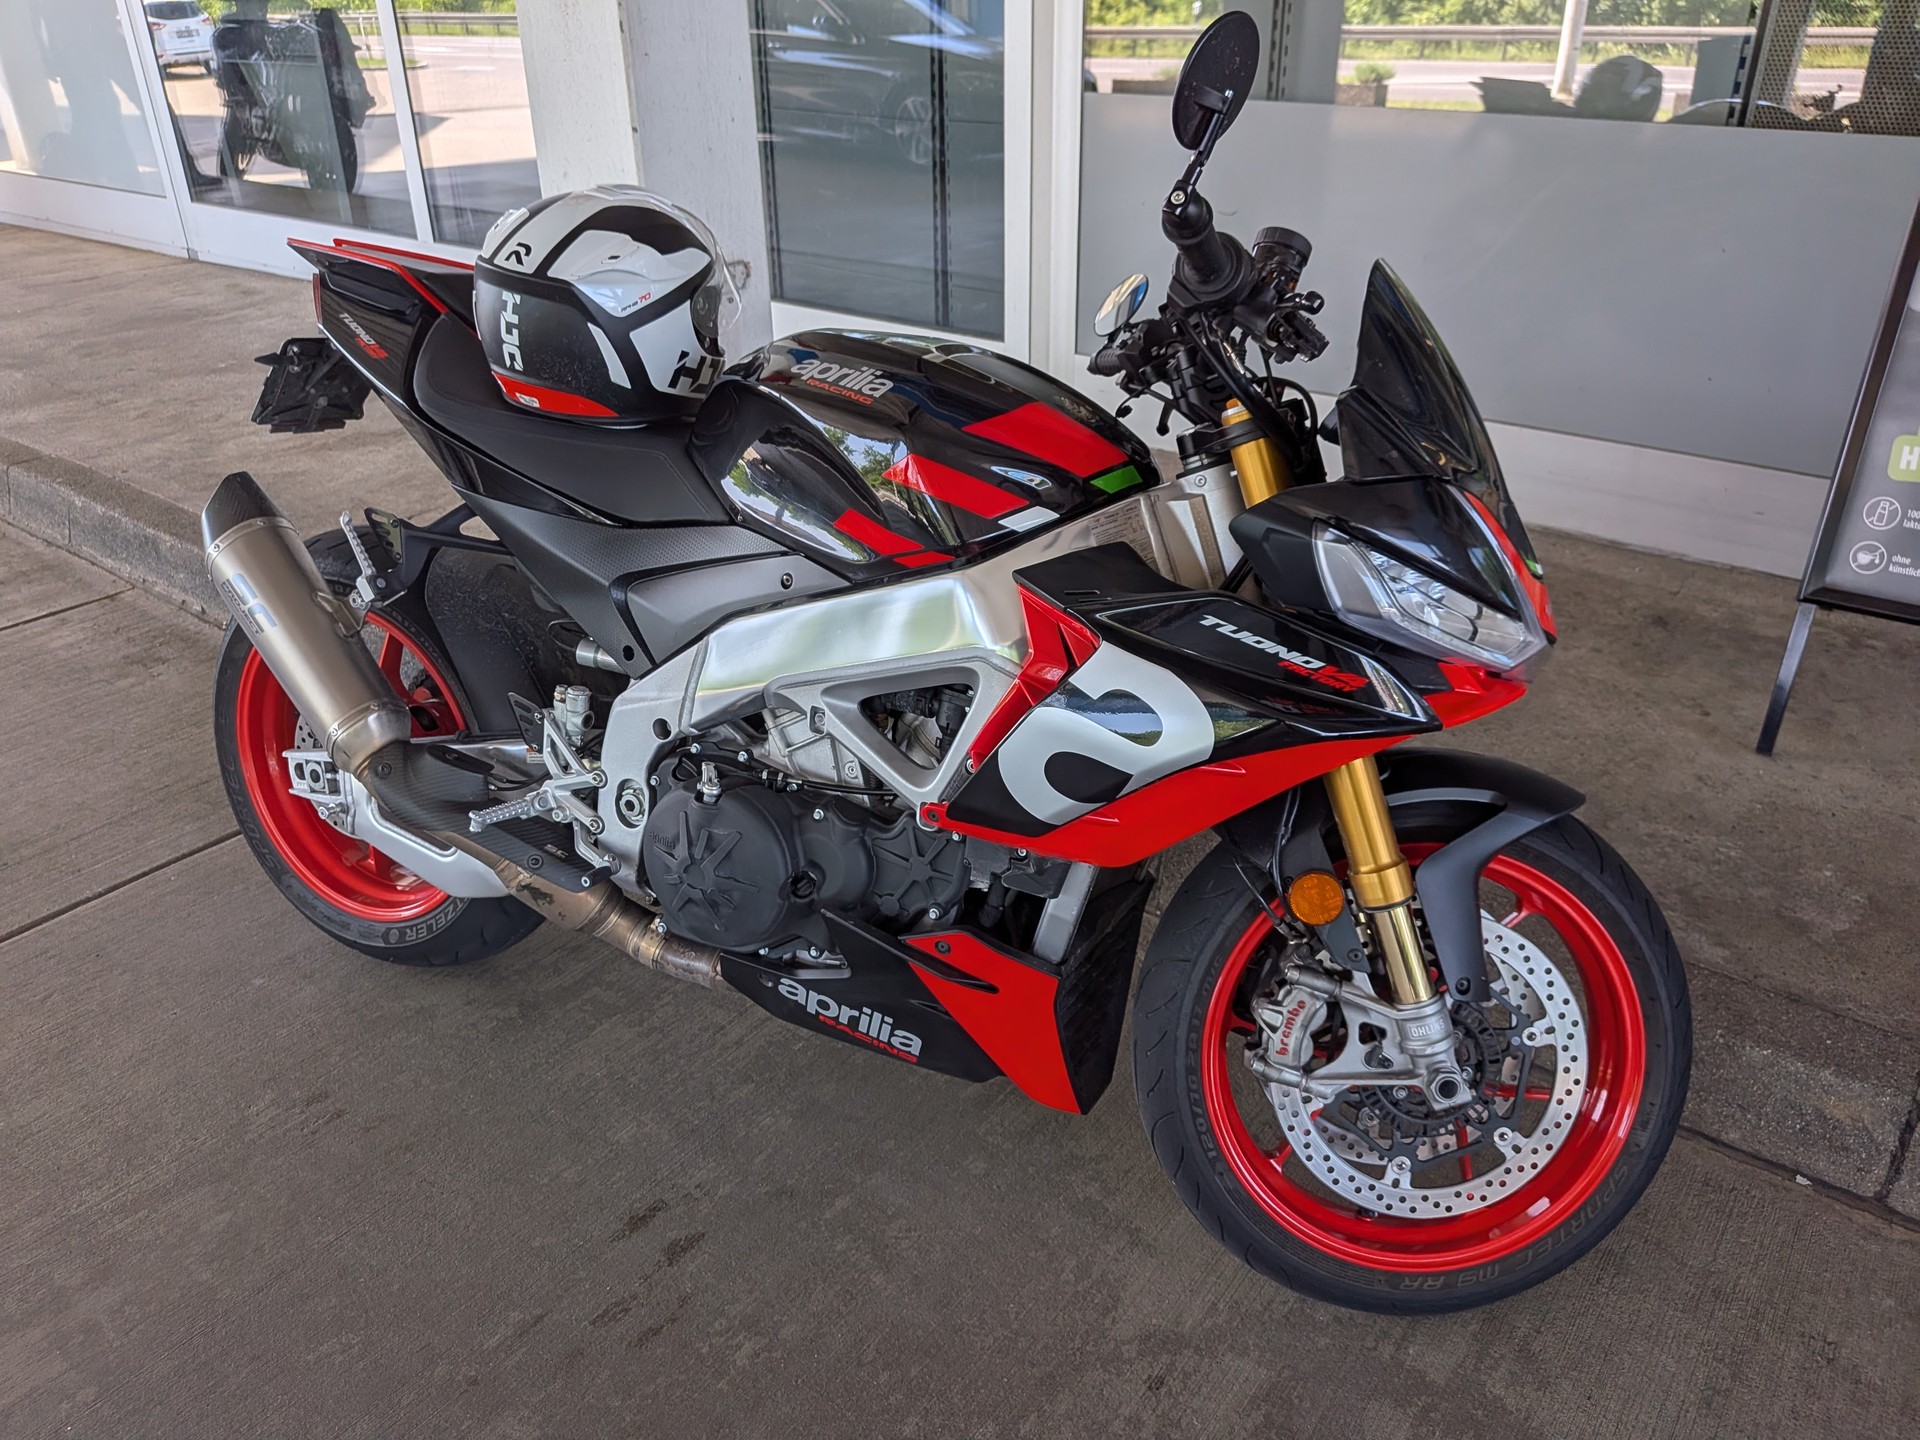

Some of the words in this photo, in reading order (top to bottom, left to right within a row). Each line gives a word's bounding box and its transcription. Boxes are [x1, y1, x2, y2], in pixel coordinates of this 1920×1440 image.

[339, 312, 376, 345] TUONO
[501, 290, 524, 371] HJC
[790, 359, 895, 398] aprilia
[805, 379, 874, 406] RACING
[1892, 554, 1911, 565] ohne
[1199, 614, 1327, 669] TUONO
[1318, 664, 1370, 692] V4
[1277, 660, 1357, 692] FACTORY
[405, 898, 467, 938] TZELER
[778, 977, 923, 1057] aprilia
[1275, 999, 1307, 1057] brembo
[818, 1014, 918, 1063] RACING
[1516, 1164, 1628, 1271] SPORTEC
[1400, 1274, 1447, 1290] RR
